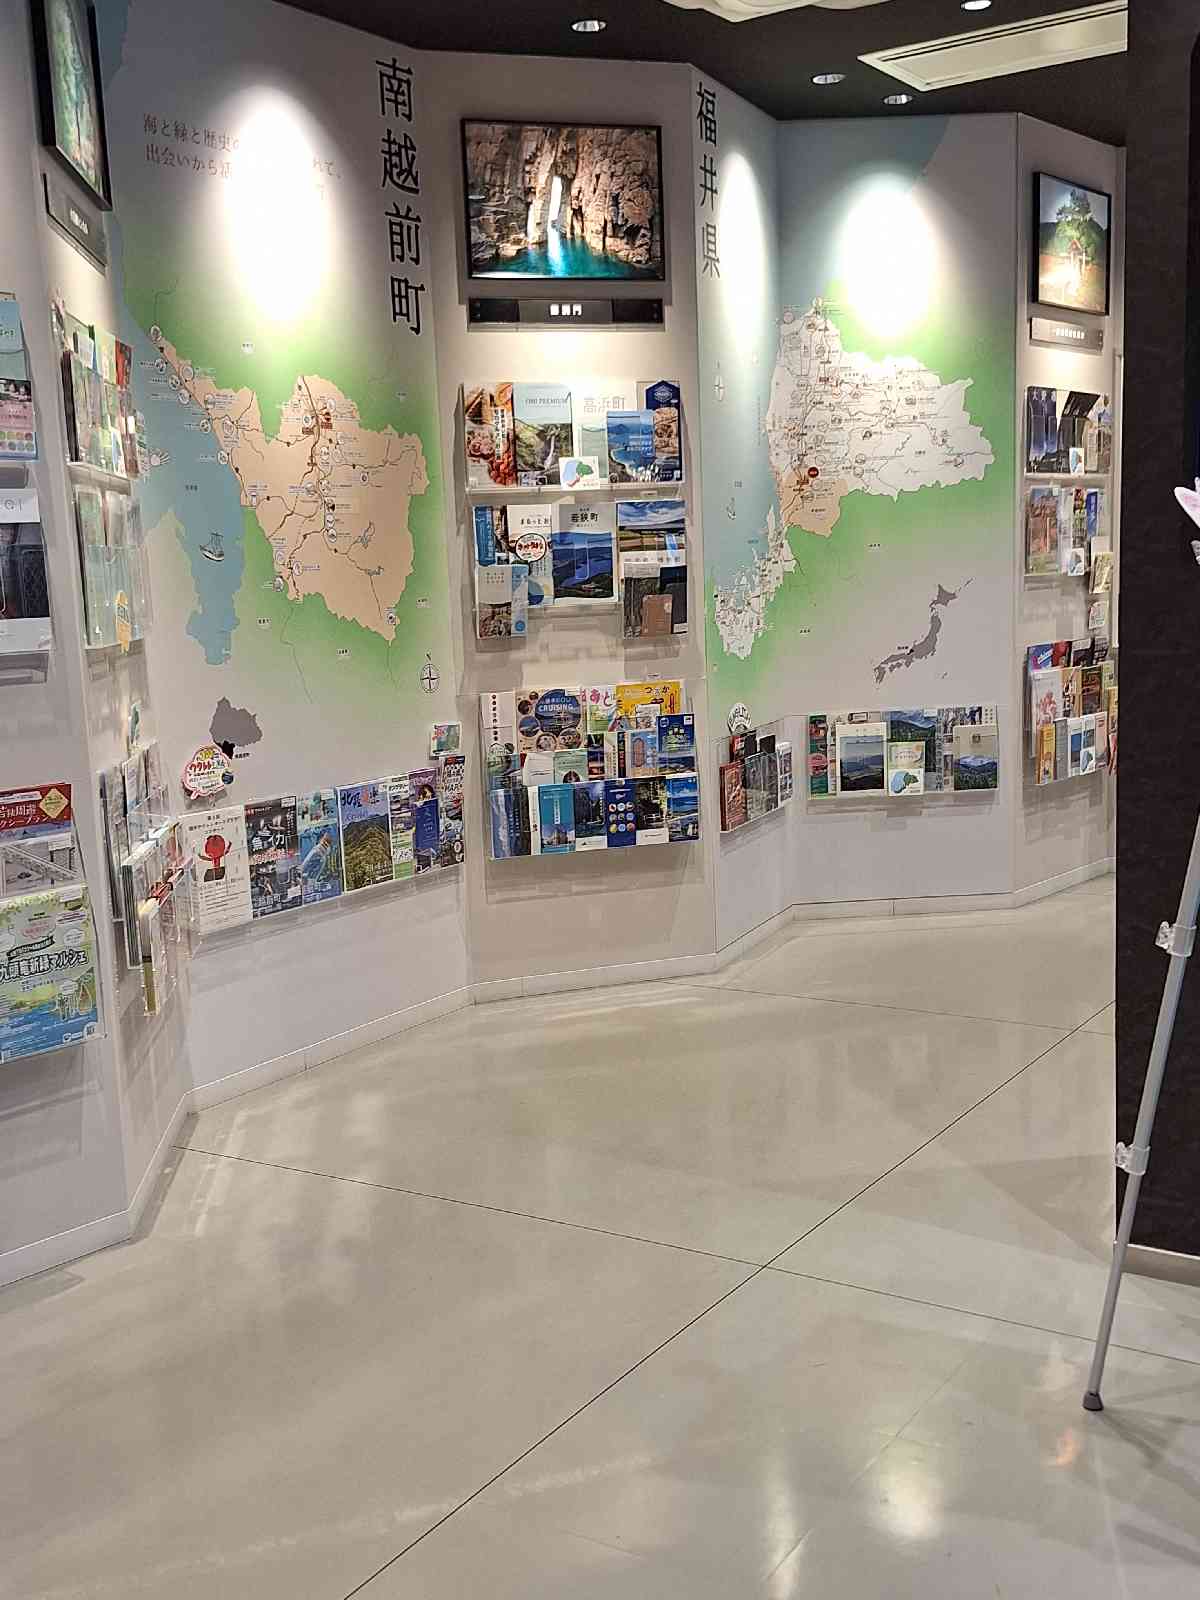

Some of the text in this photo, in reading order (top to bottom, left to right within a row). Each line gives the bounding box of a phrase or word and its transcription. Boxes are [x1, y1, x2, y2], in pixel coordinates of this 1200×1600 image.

[376, 58, 425, 335] 南越前町
[696, 82, 721, 278] 福井県
